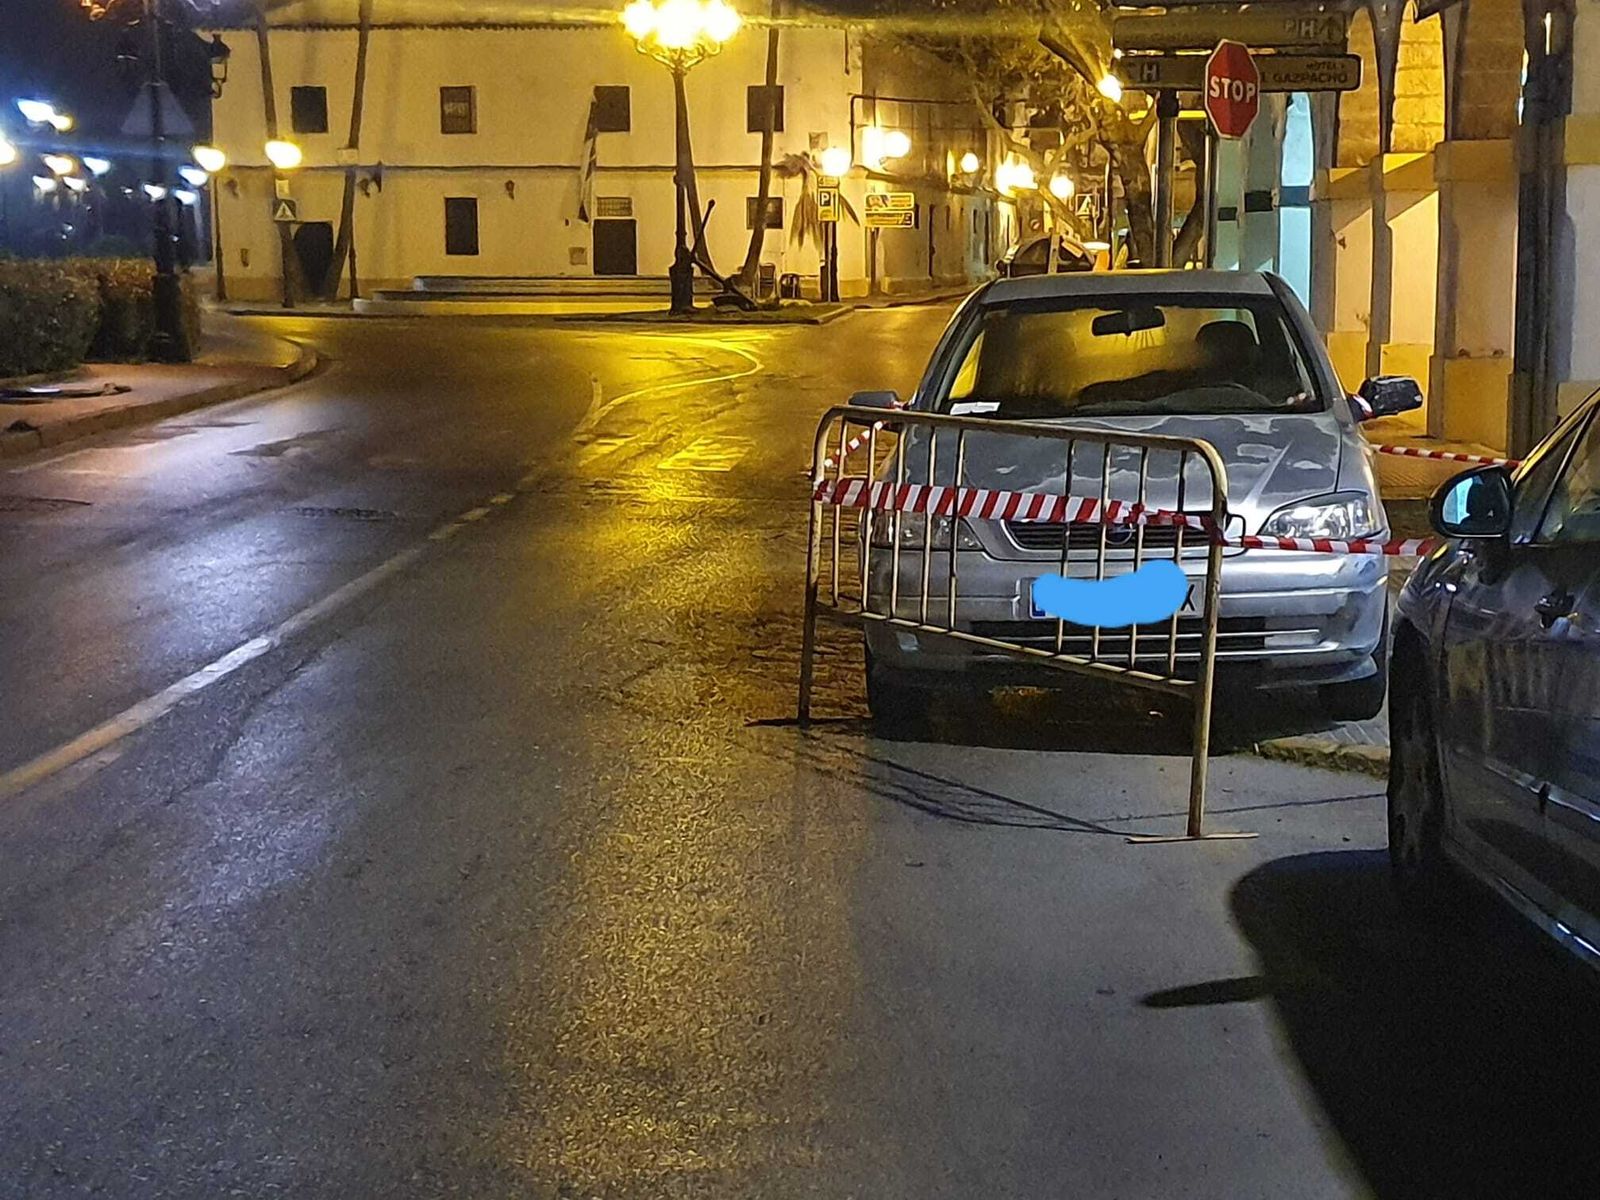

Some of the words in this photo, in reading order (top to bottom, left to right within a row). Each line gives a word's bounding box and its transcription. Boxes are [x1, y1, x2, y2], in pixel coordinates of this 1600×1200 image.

[1273, 72, 1348, 84] GAZPACHO
[1209, 75, 1256, 104] STOP
[821, 192, 829, 206] P
